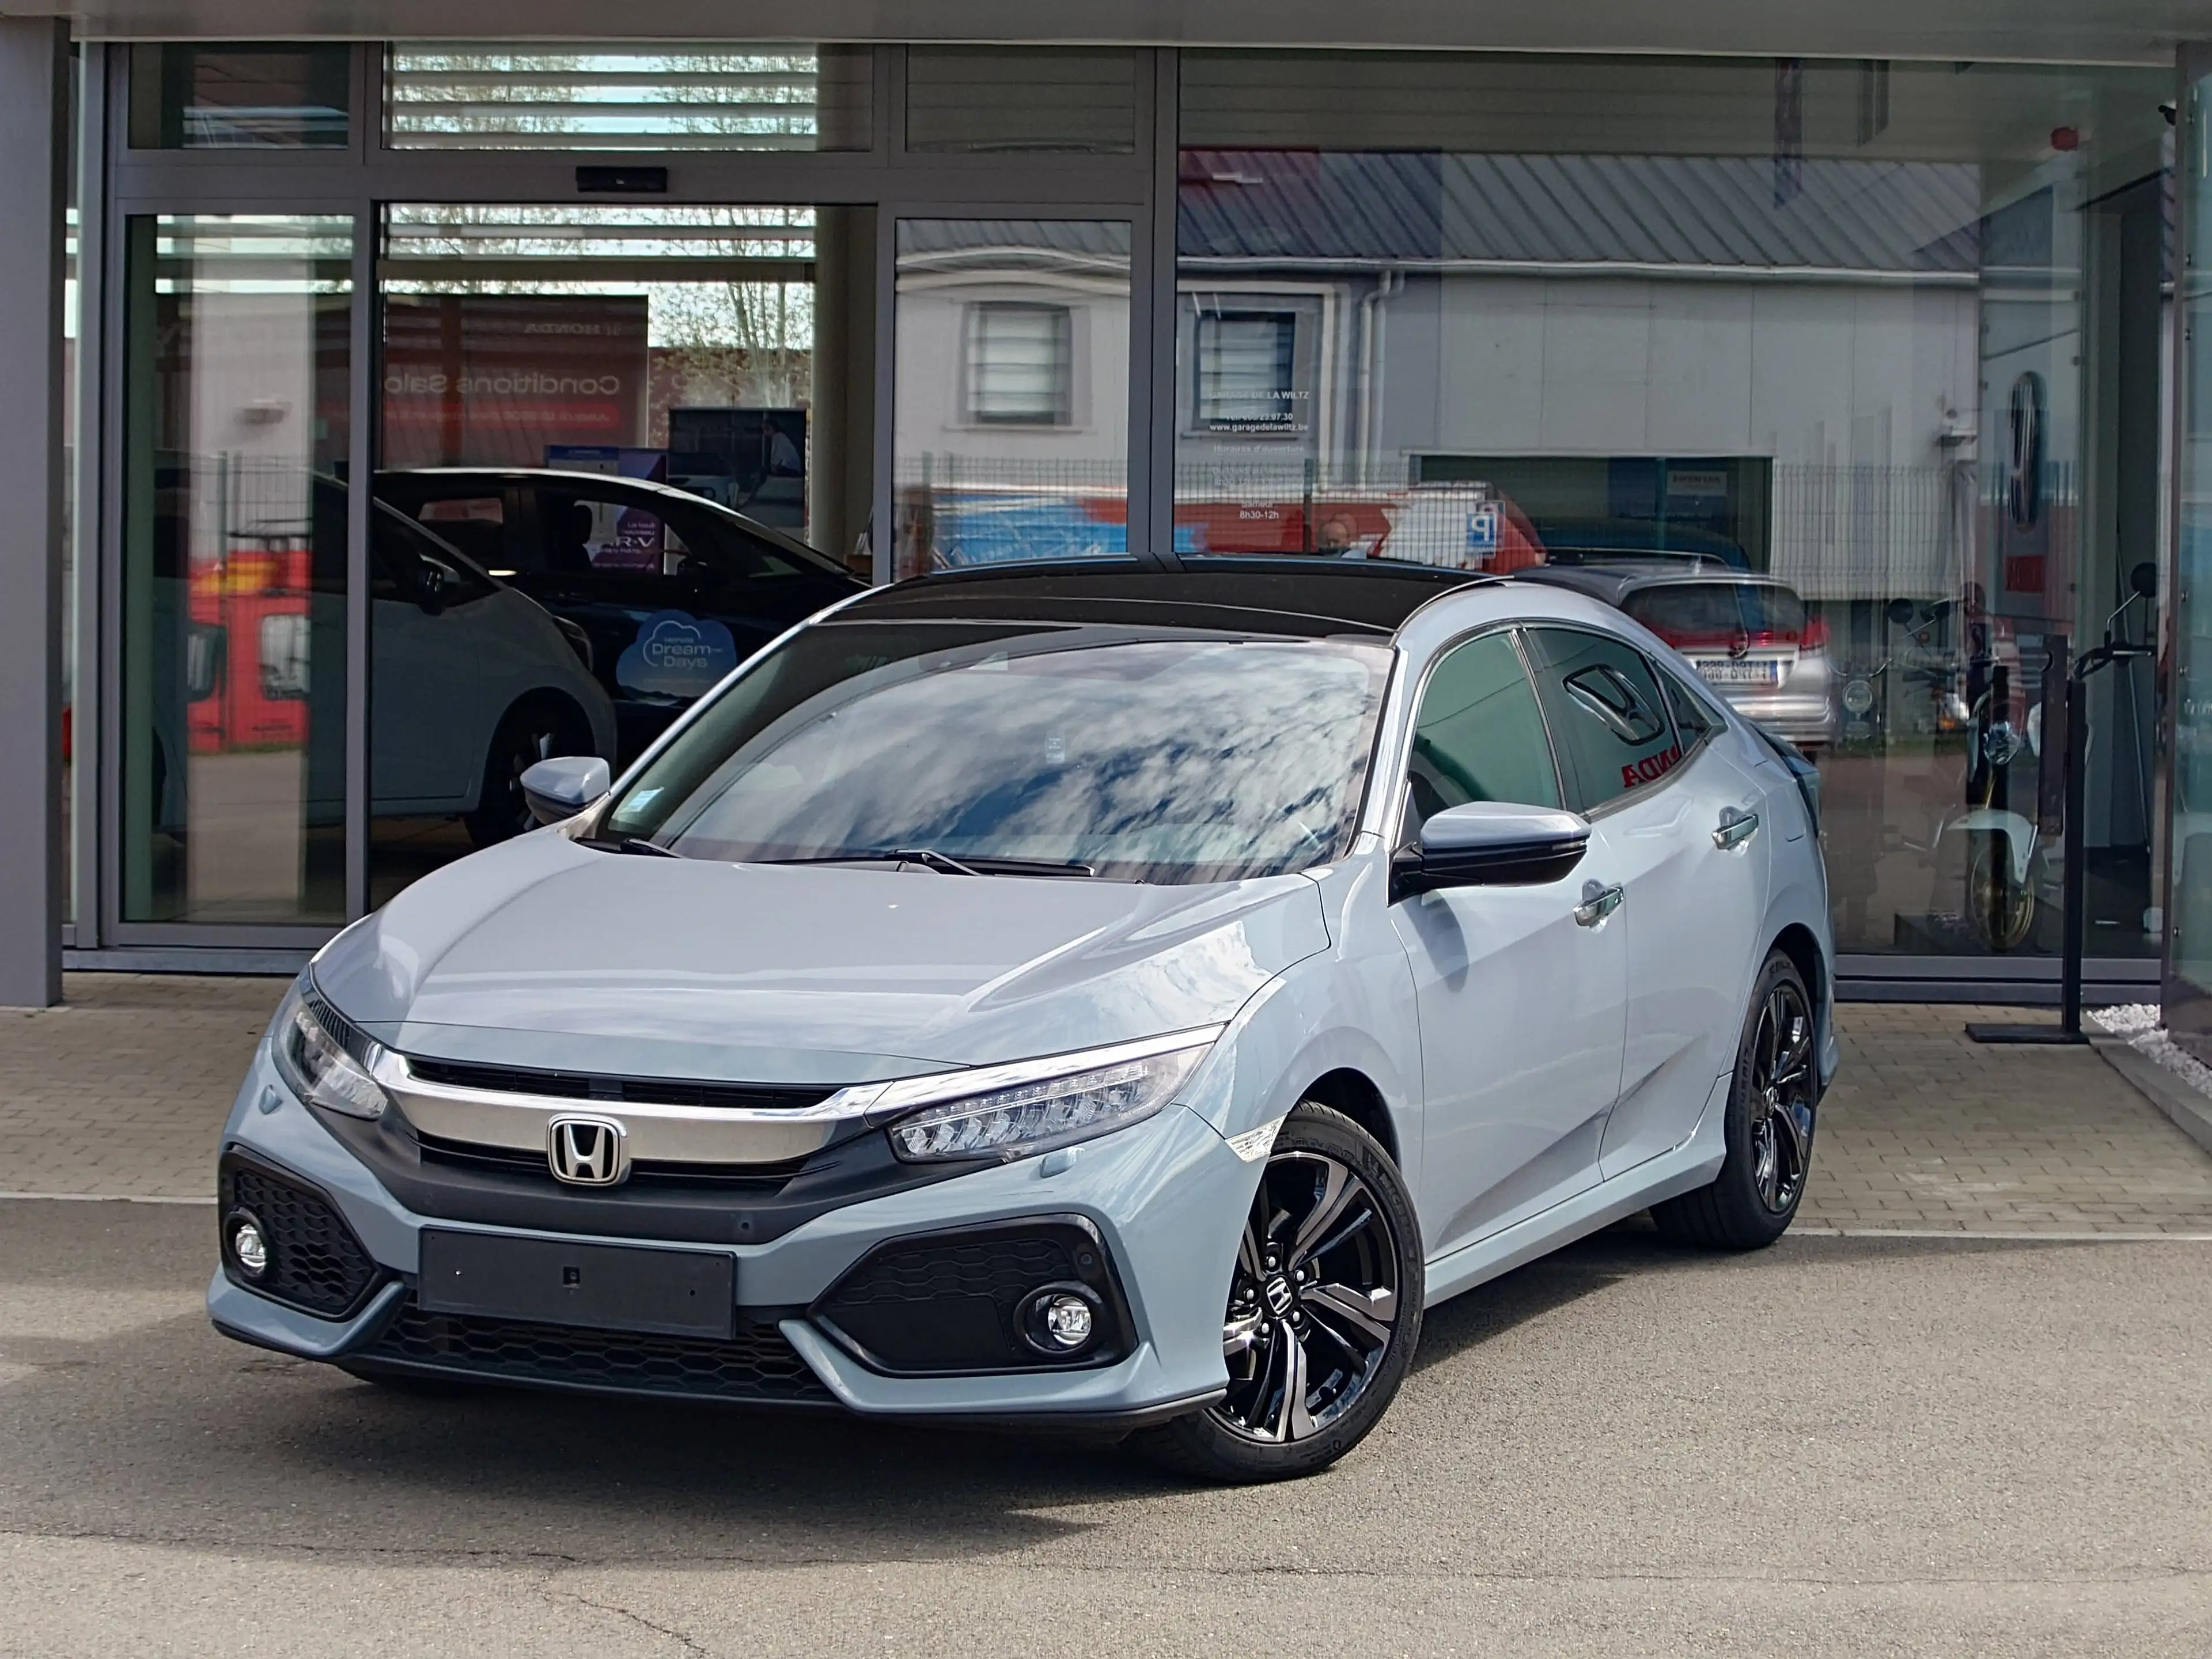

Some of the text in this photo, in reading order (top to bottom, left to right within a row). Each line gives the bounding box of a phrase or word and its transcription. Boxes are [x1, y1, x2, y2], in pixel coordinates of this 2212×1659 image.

[1267, 391, 1280, 399] LA
[1281, 391, 1309, 399] WILTZ
[1210, 423, 1309, 433] www.garagedelawiltz.be
[1240, 510, 1279, 518] 8h30-12h
[611, 536, 655, 547] R-V
[652, 643, 711, 655] Dream
[664, 655, 708, 669] Days
